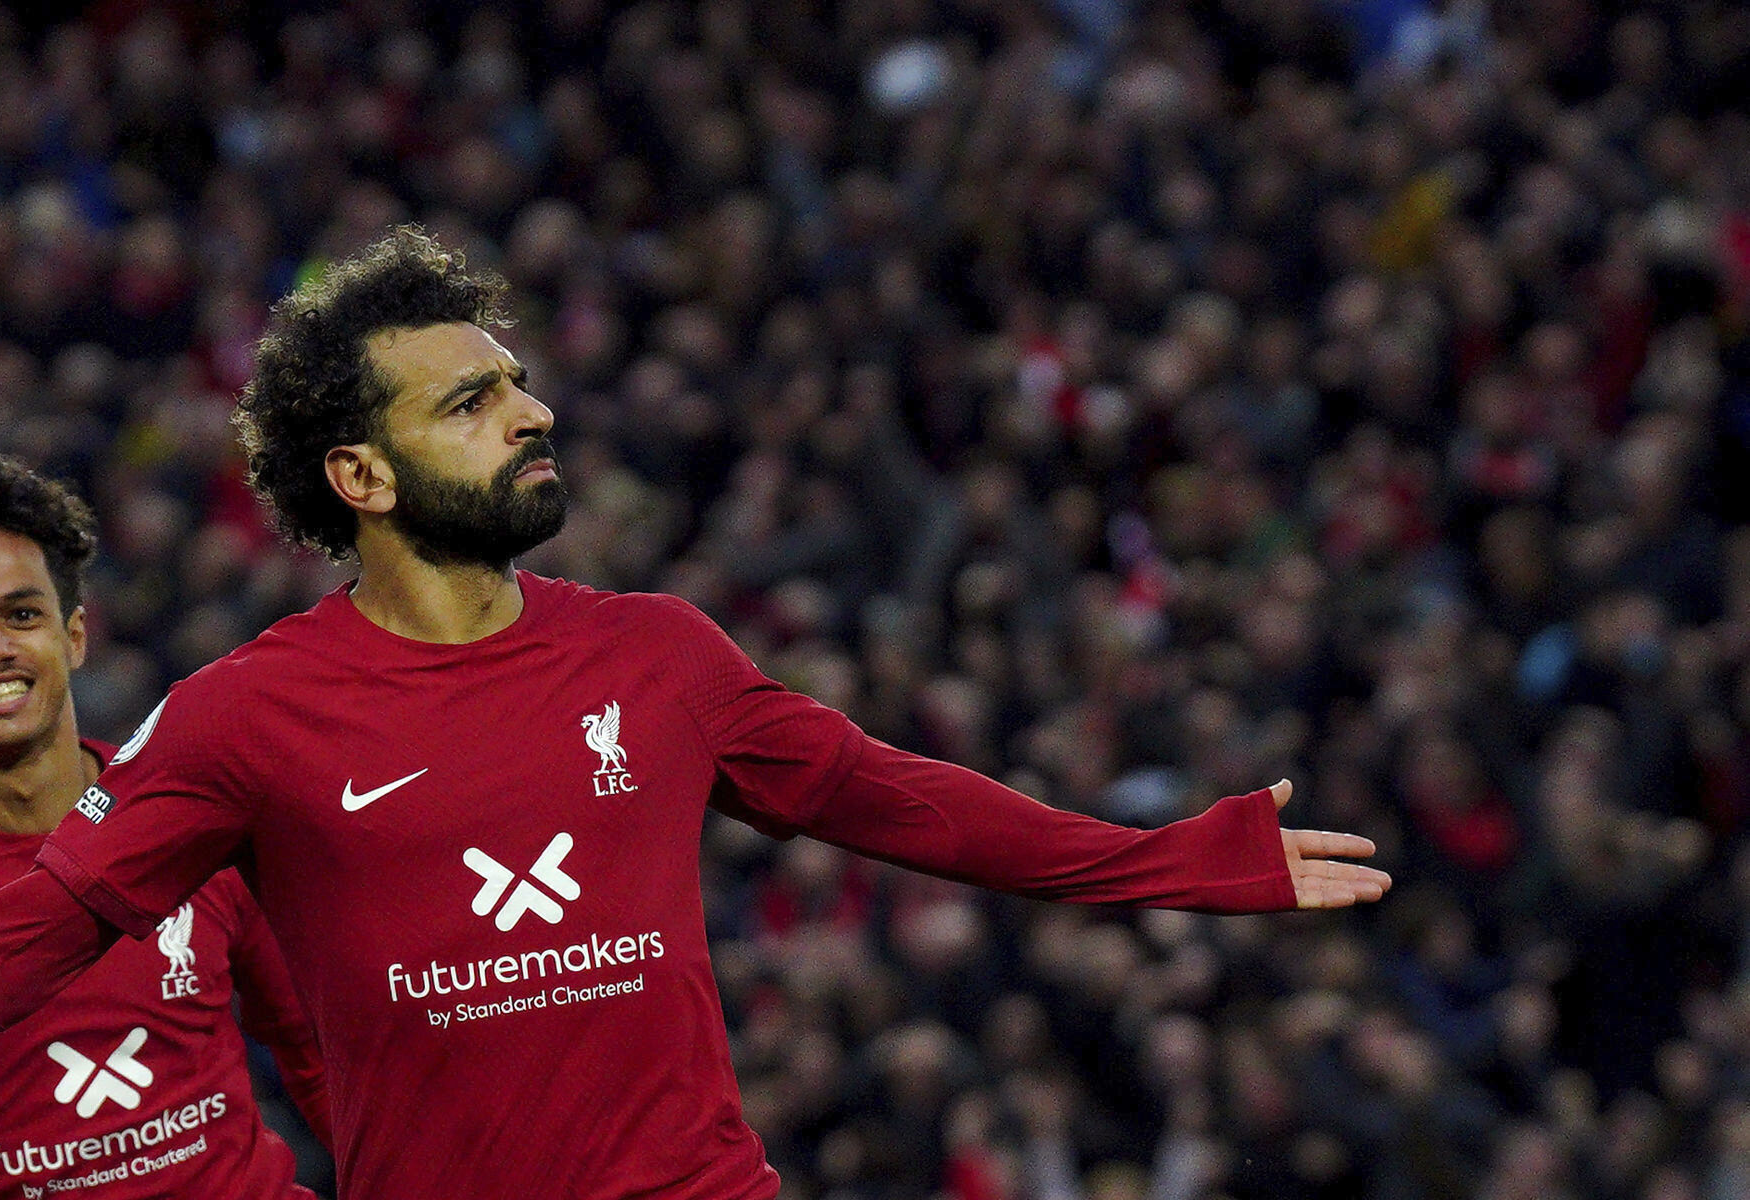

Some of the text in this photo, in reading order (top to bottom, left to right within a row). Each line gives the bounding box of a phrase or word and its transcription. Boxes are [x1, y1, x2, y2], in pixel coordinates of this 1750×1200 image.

[387, 931, 664, 1002] futuremakers
[428, 973, 644, 1029] by Standard Chartered
[22, 1134, 207, 1200] by Standard Chartered
